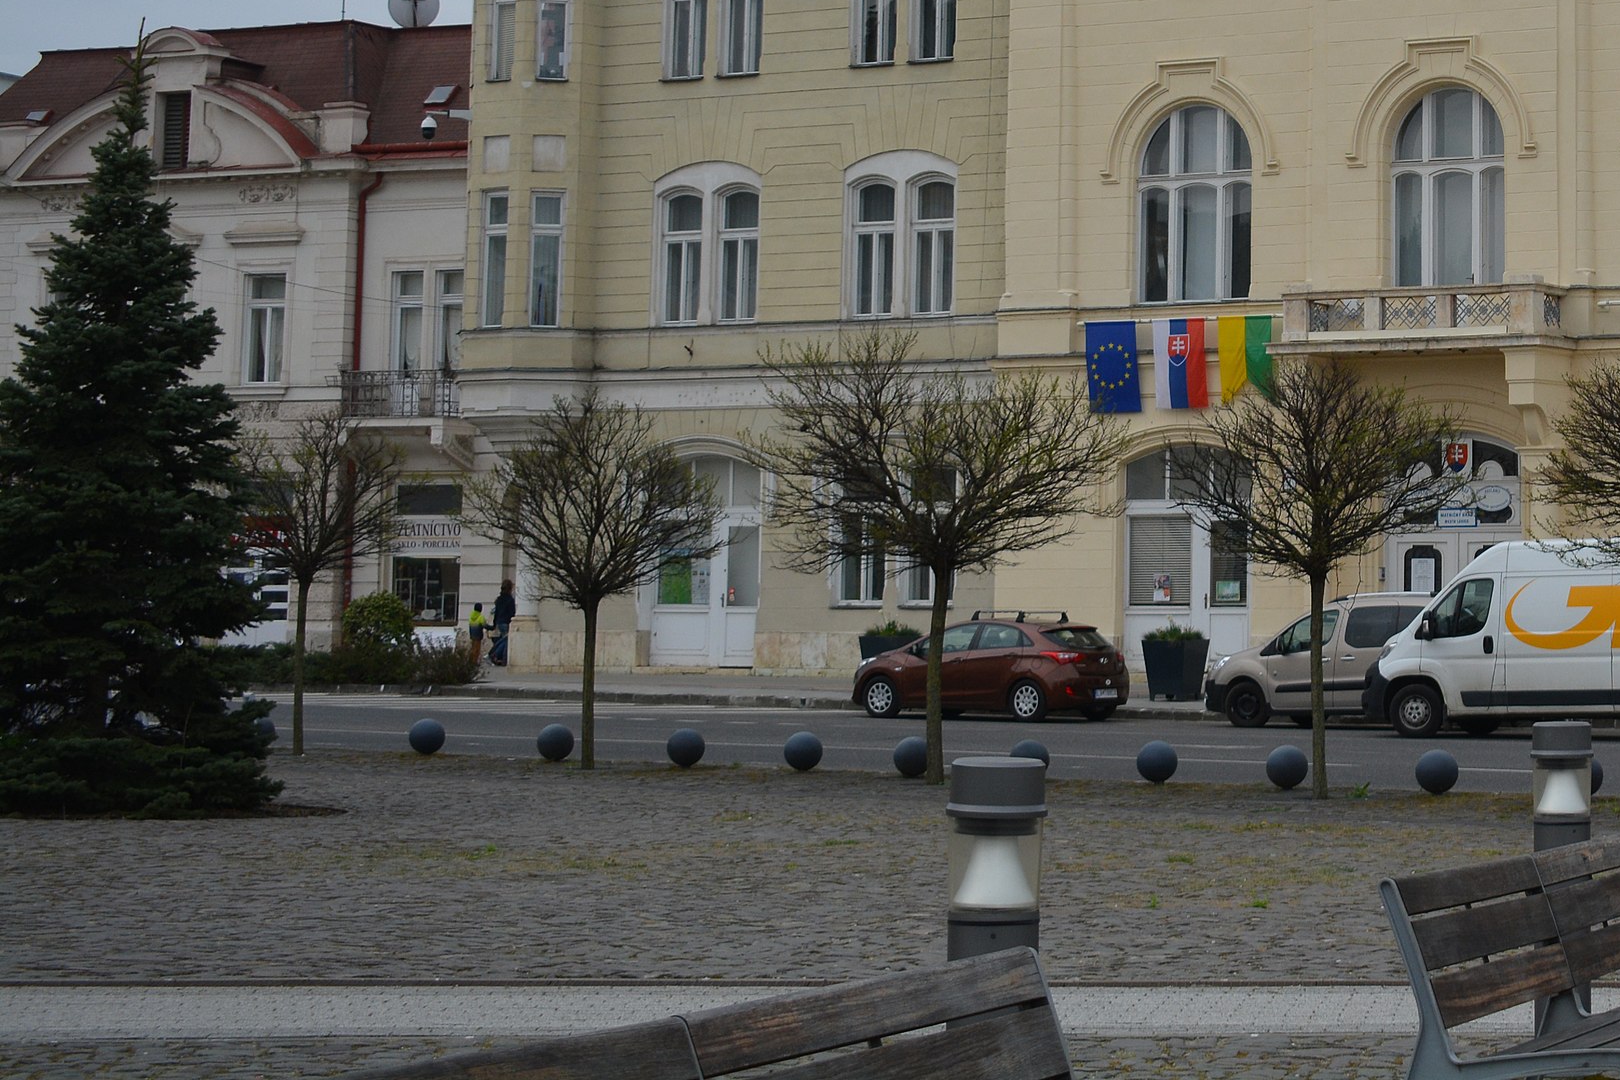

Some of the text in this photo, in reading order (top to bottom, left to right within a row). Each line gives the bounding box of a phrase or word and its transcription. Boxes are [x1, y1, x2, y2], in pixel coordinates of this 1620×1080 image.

[398, 520, 460, 536] ZLATNÍCTVO
[398, 540, 416, 548] SKLO
[422, 539, 460, 548] PORCELÁN
